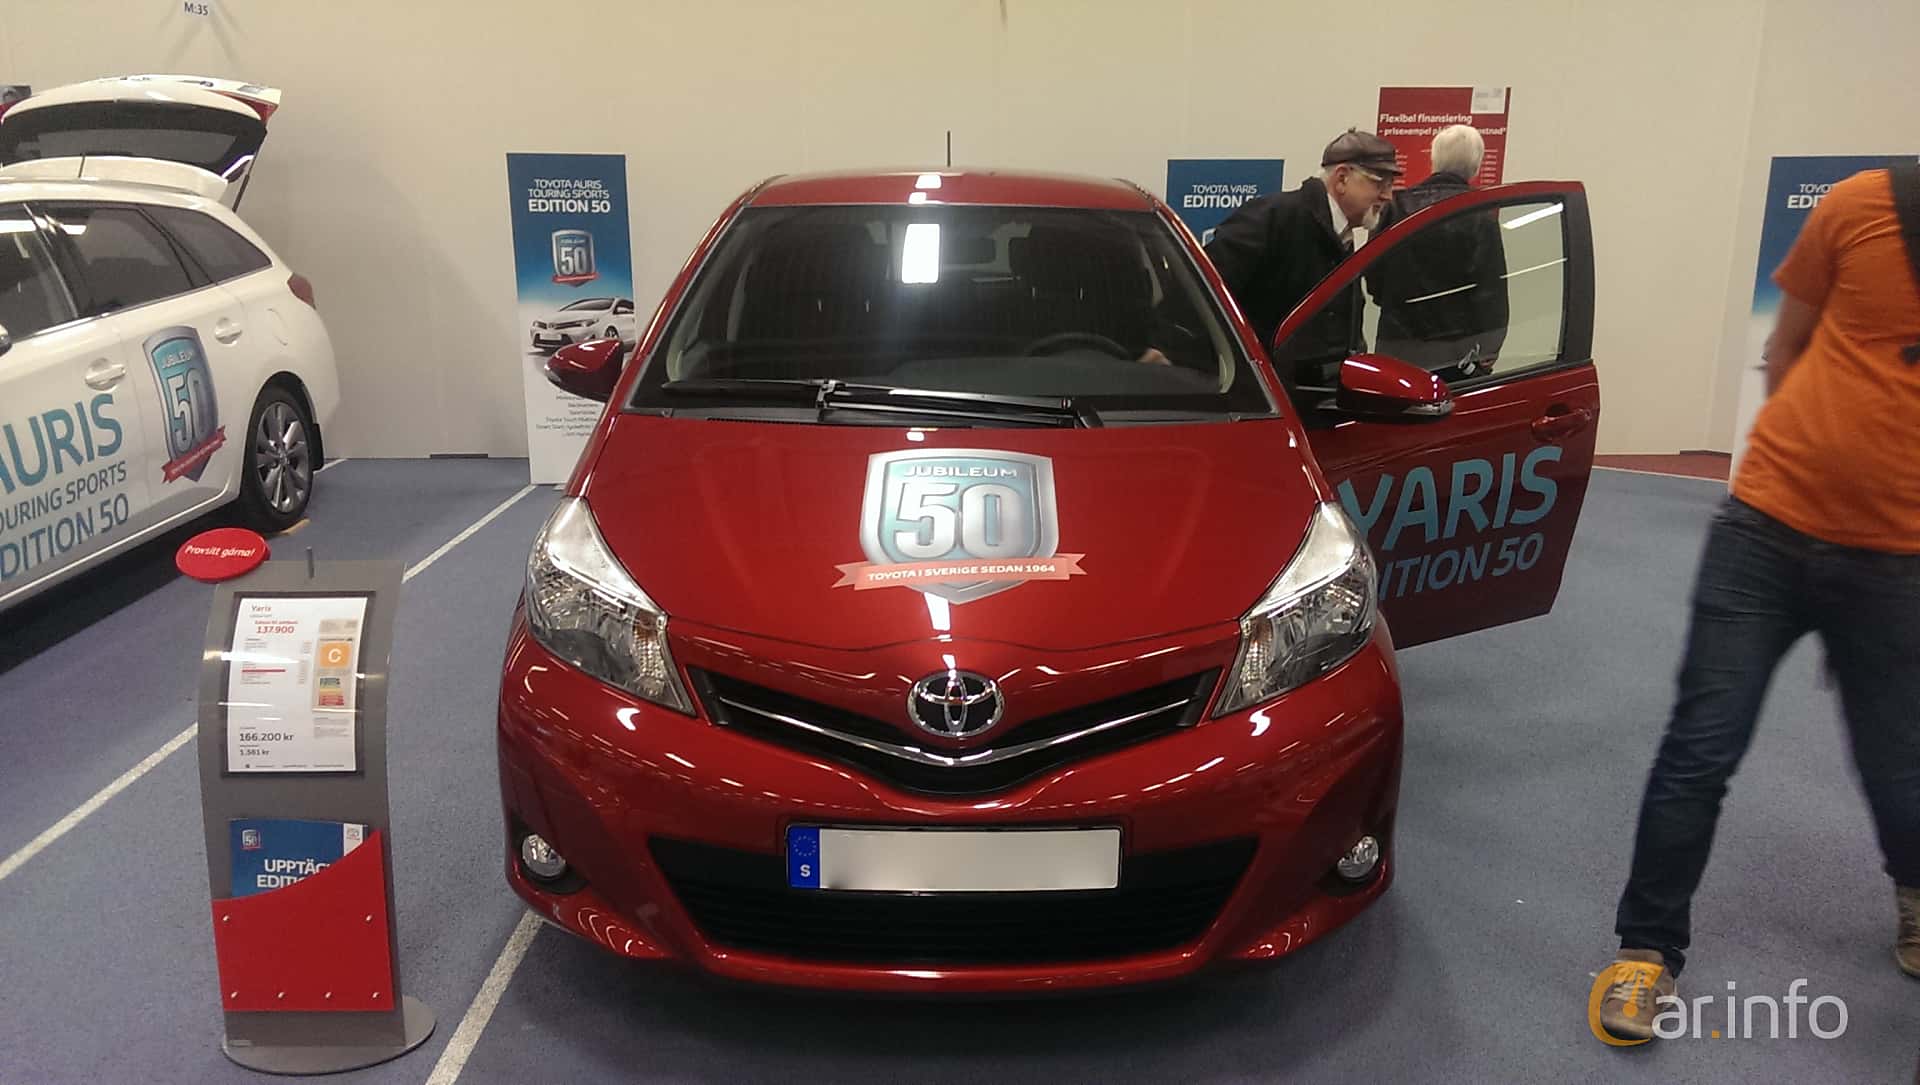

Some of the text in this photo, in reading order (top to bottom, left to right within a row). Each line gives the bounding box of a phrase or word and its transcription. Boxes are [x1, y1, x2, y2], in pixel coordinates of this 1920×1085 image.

[184, 1, 208, 16] M:35
[1379, 113, 1473, 125] Flexibel finansiering
[1384, 127, 1431, 136] prisexempel
[534, 179, 602, 189] TOYOTA AURIS
[1192, 184, 1257, 194] TOYOTA YARIS
[528, 189, 610, 199] TOURING SPORTS
[528, 199, 611, 213] EDITION 50
[1183, 195, 1242, 208] EDITION
[560, 246, 588, 275] 50
[166, 368, 204, 454] 50
[904, 466, 1017, 478] JUBILEUM
[66, 461, 127, 505] SPORTS
[1337, 446, 1563, 551] YARIS
[100, 493, 129, 534] 50
[895, 482, 1028, 559] 50
[1492, 532, 1545, 577] 50
[868, 570, 917, 581] TOYOTA
[925, 566, 978, 576] SVERIGE
[980, 564, 1024, 575] SEDAN
[1025, 564, 1055, 573] 1964
[328, 648, 341, 663] C
[240, 732, 294, 741] 166.200 kr
[800, 864, 811, 878] S
